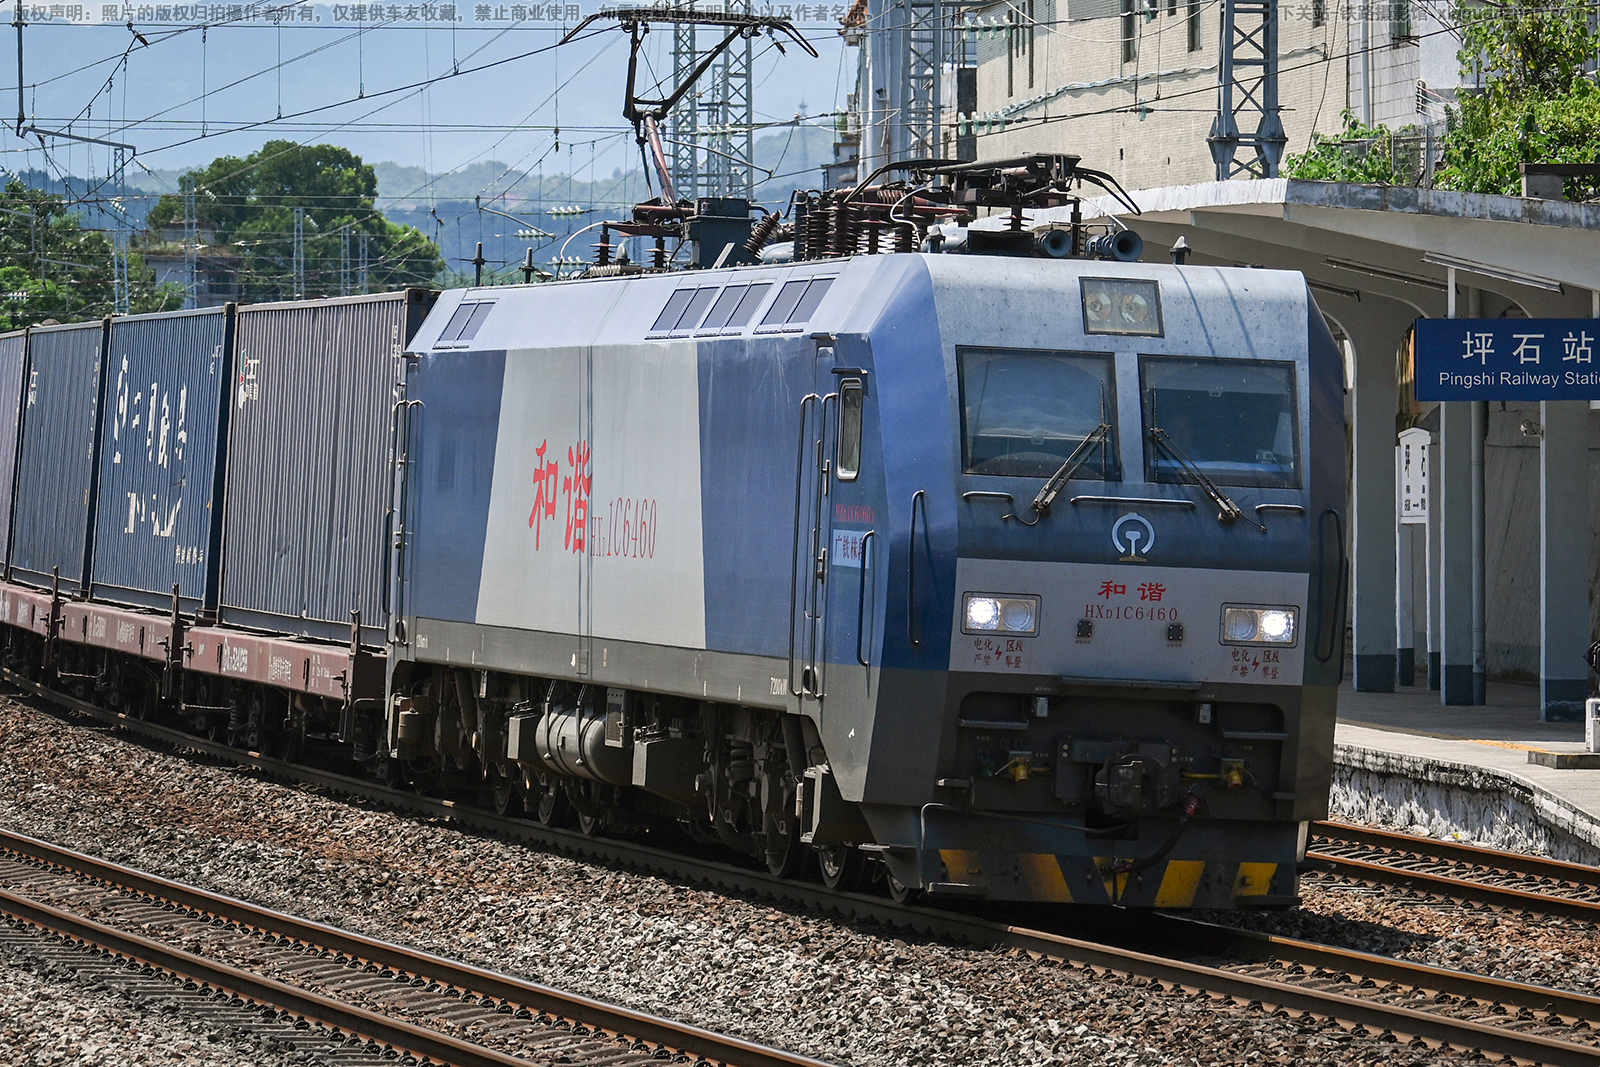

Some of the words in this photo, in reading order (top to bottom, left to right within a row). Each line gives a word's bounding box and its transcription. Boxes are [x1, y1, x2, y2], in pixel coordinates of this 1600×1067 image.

[1461, 330, 1595, 365] 坪石站
[1439, 372, 1495, 389] Pingshi
[1500, 371, 1559, 389] Railway
[1564, 371, 1600, 386] Stati
[529, 438, 593, 554] 和谐
[1097, 580, 1167, 602] 和谐
[1085, 604, 1179, 622] HXD1C6460
[973, 638, 993, 651] 电化
[1005, 638, 1024, 653] 区段
[972, 653, 992, 667] 严禁
[1004, 653, 1023, 669] 攀登
[1230, 649, 1250, 663] 电化
[1262, 650, 1281, 665] 区段
[1229, 664, 1249, 678] 严禁
[1261, 665, 1280, 681] 攀登
